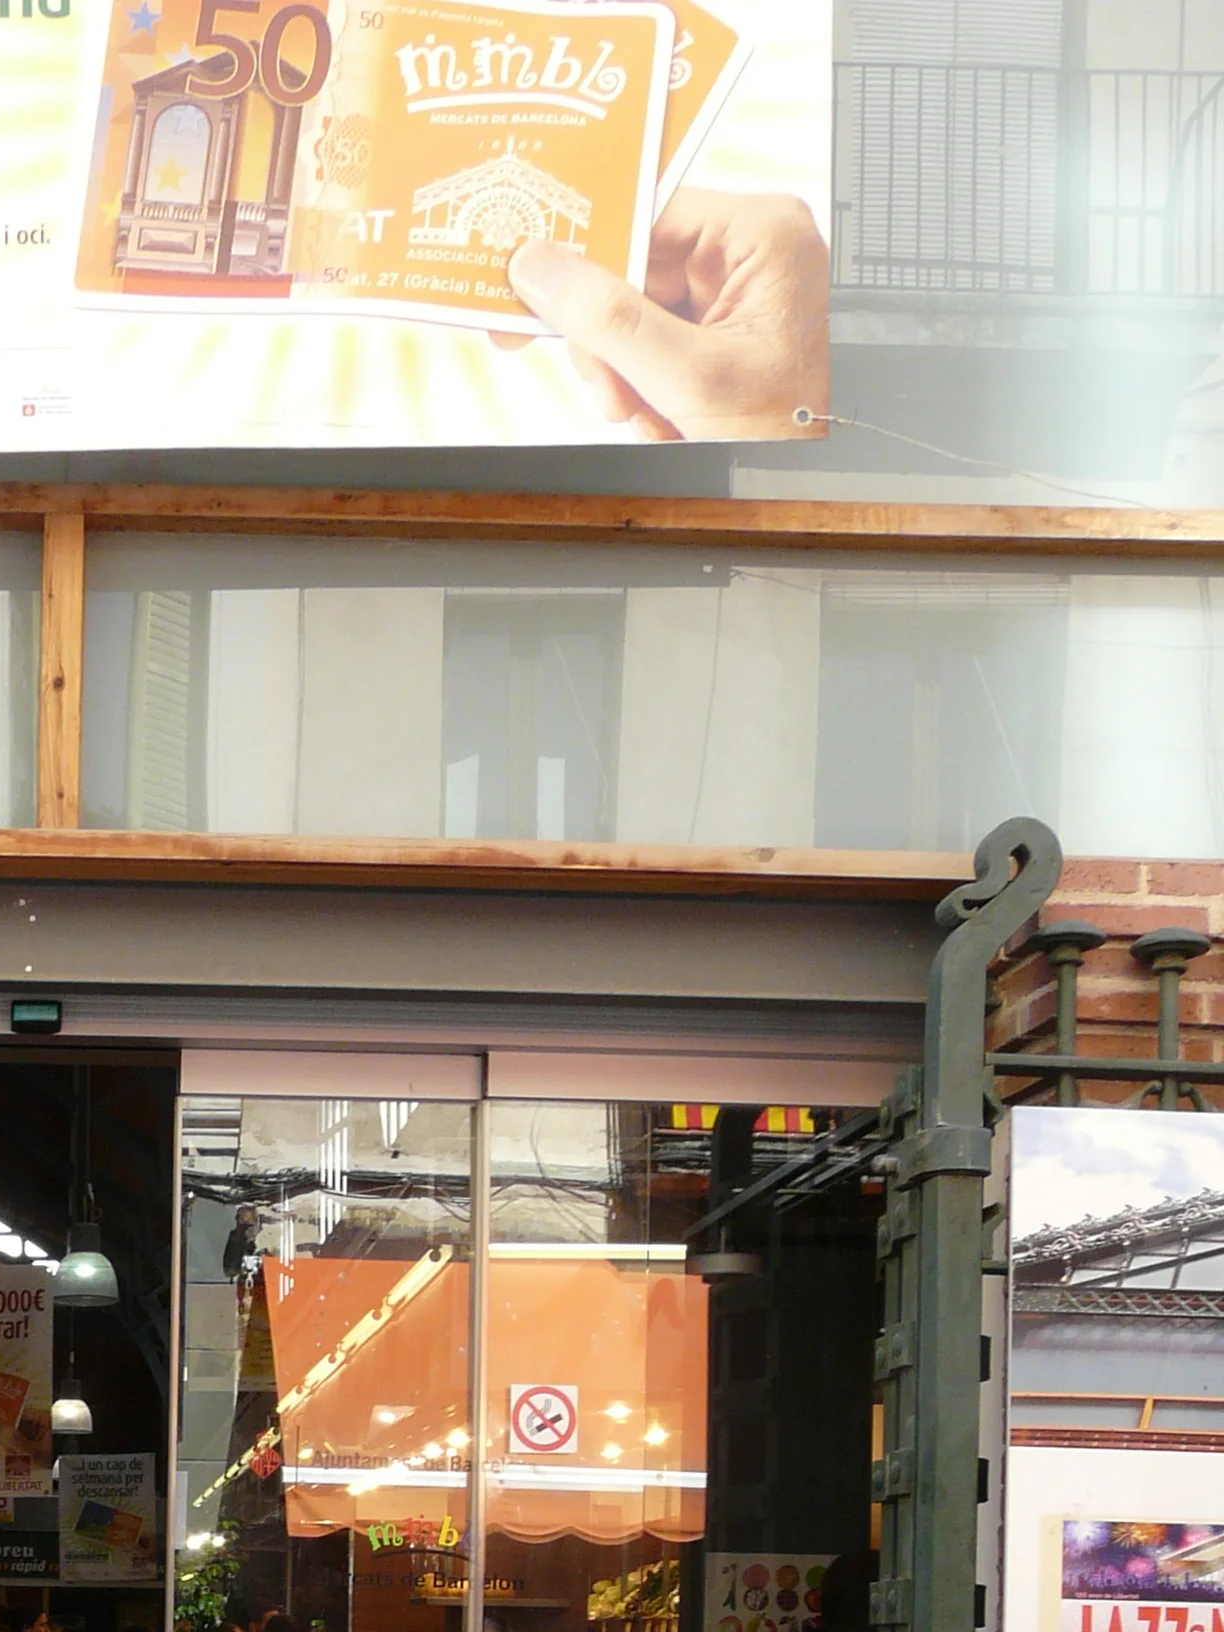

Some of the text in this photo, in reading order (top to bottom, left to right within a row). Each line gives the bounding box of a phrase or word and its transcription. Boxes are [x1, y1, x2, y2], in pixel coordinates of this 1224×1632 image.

[358, 10, 384, 29] 50
[184, 0, 333, 107] 50
[429, 112, 587, 127] MERCATS DE BARCELONA
[3, 224, 10, 245] i
[16, 223, 52, 246] oci.
[322, 266, 348, 285] 50
[376, 272, 399, 287] 27
